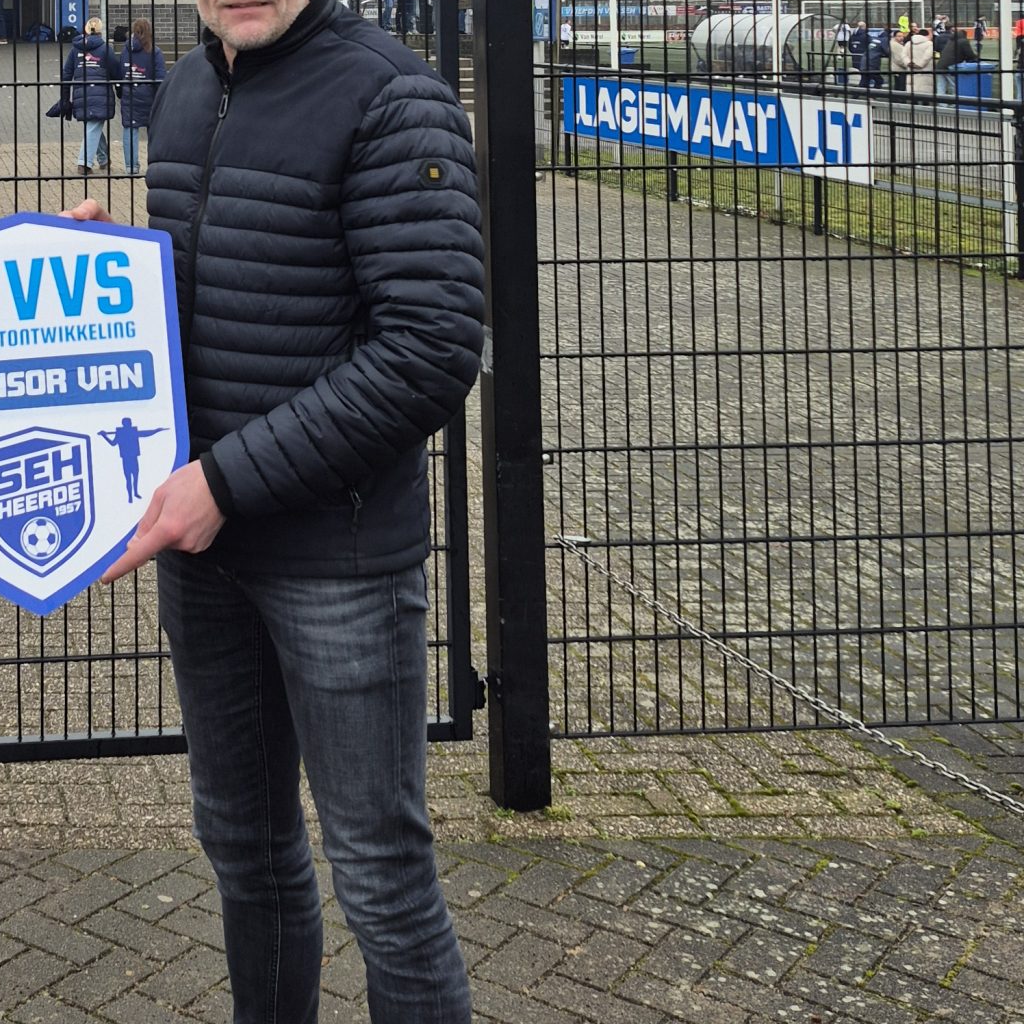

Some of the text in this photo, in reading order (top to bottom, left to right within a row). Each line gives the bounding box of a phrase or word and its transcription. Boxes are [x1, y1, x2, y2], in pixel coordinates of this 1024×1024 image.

[576, 84, 777, 154] LAGEMAAT
[4, 251, 134, 321] VVS
[77, 362, 144, 392] VAN
[54, 501, 82, 517] 1957
